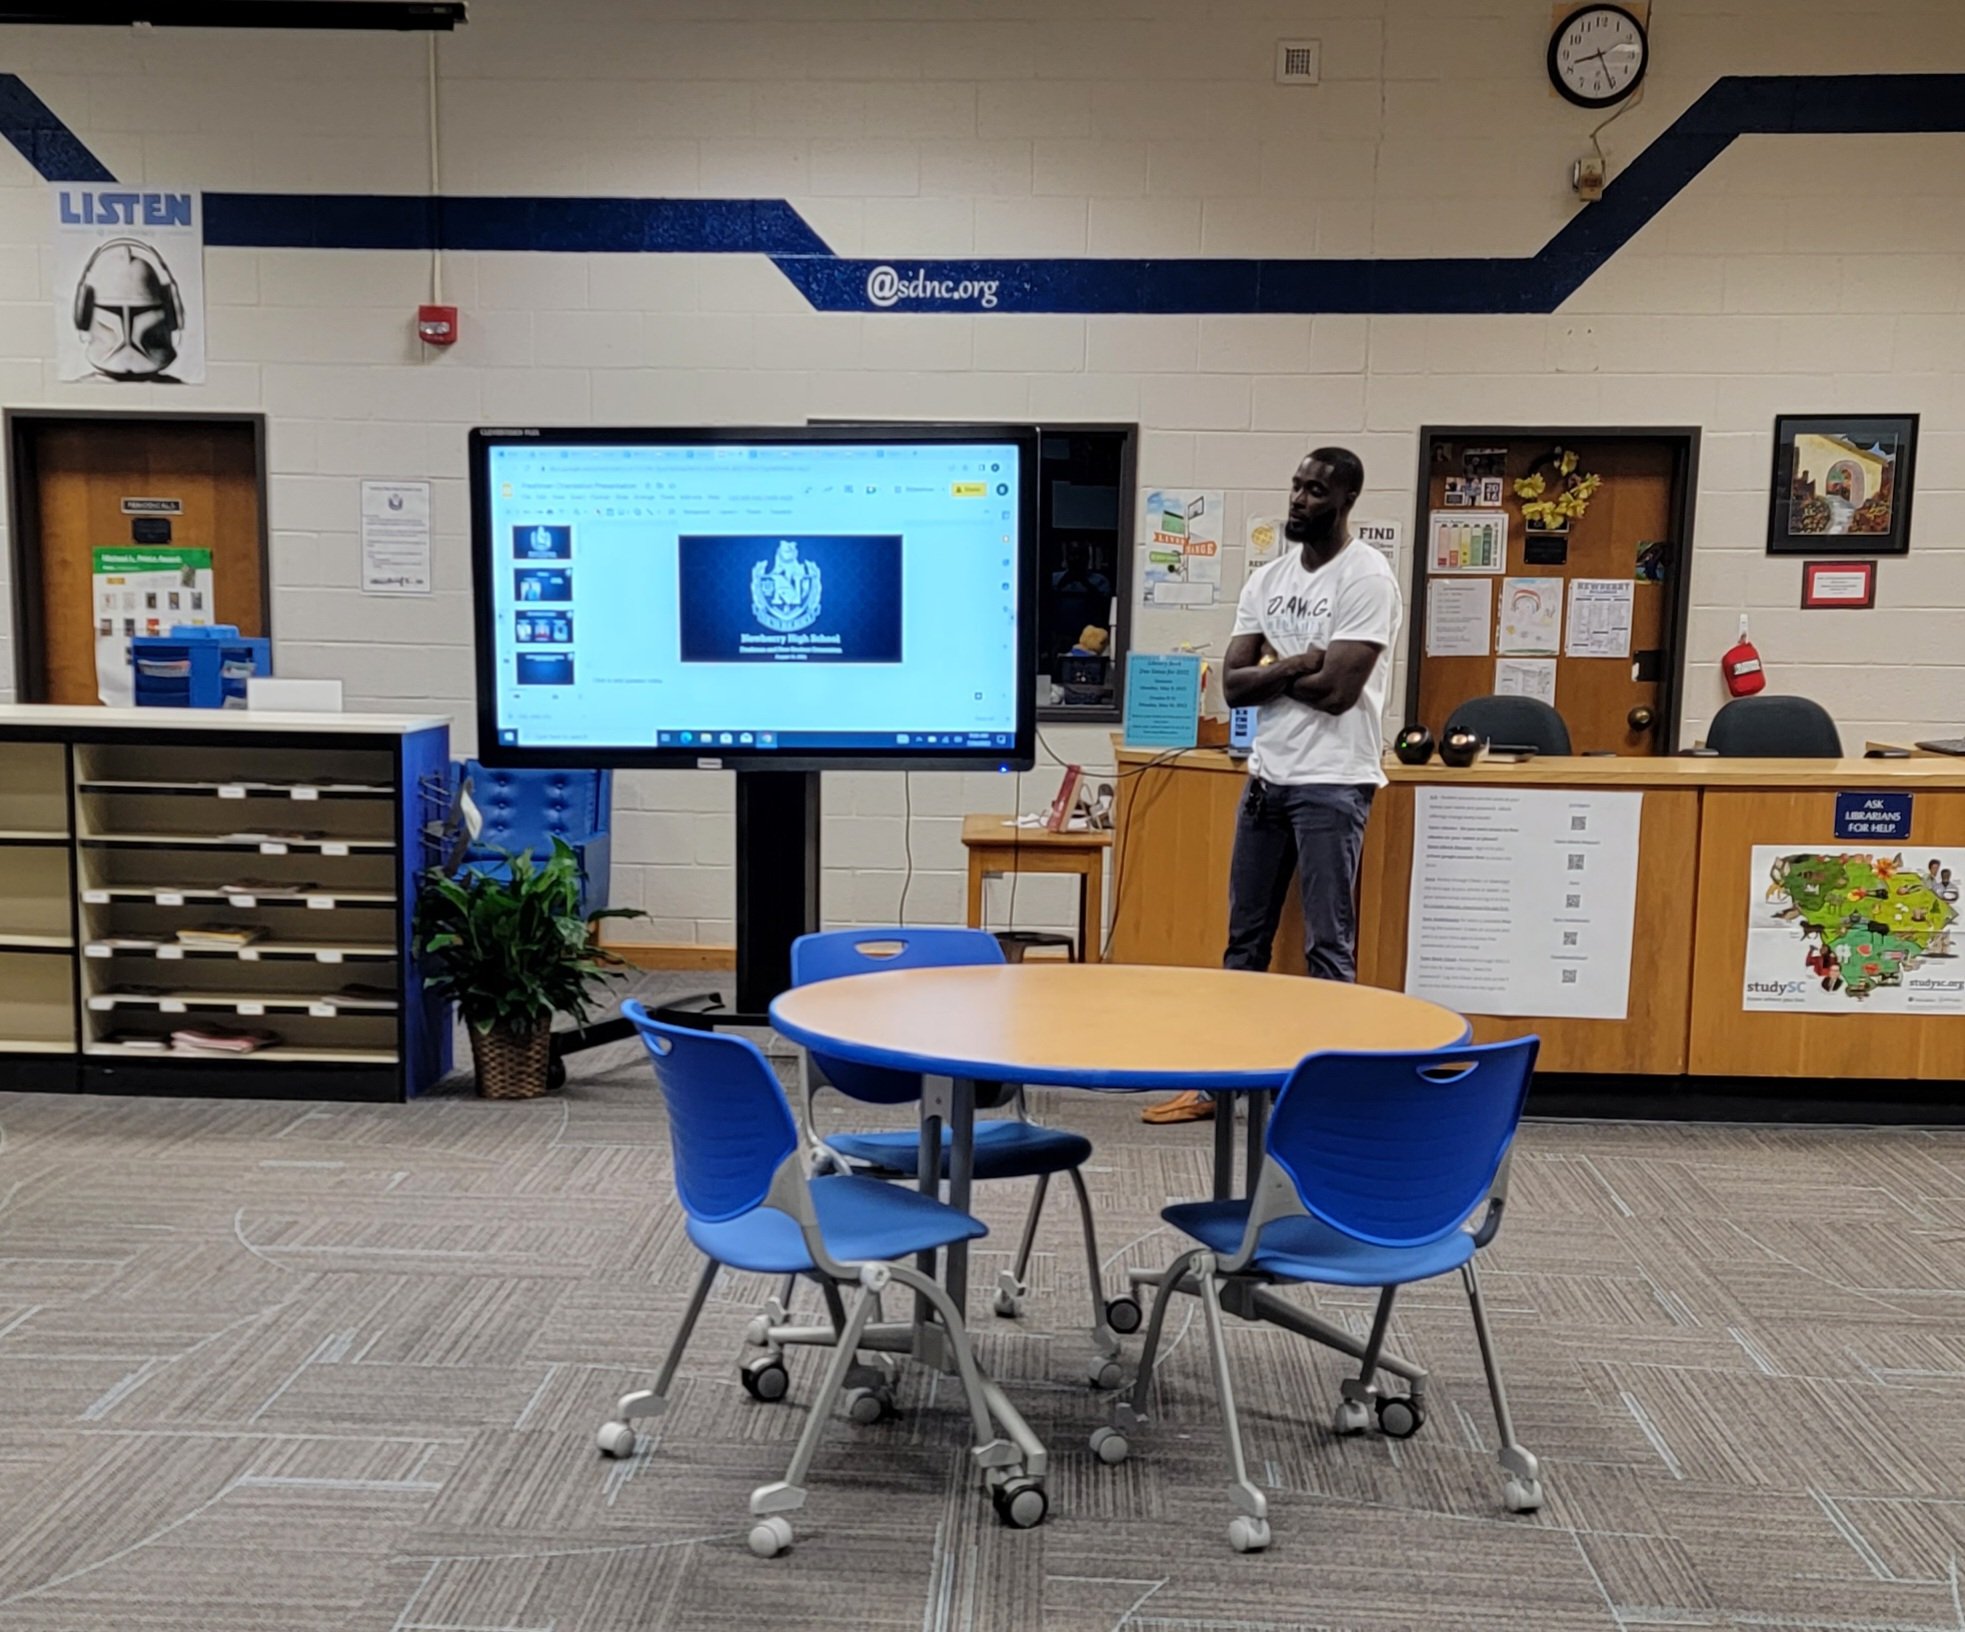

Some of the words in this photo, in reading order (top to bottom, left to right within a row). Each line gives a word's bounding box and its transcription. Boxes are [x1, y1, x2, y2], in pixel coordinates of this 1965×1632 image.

[1570, 34, 1582, 46] 10
[59, 191, 192, 226] LISTEN
[867, 265, 999, 308] @sdnc.org
[1359, 527, 1395, 540] FIND
[1863, 799, 1885, 809] ASK
[1844, 810, 1902, 822] LIBRARIANS
[1847, 823, 1869, 833] FOR
[1747, 981, 1806, 996] studySC
[1909, 978, 1965, 990] studysc.org
